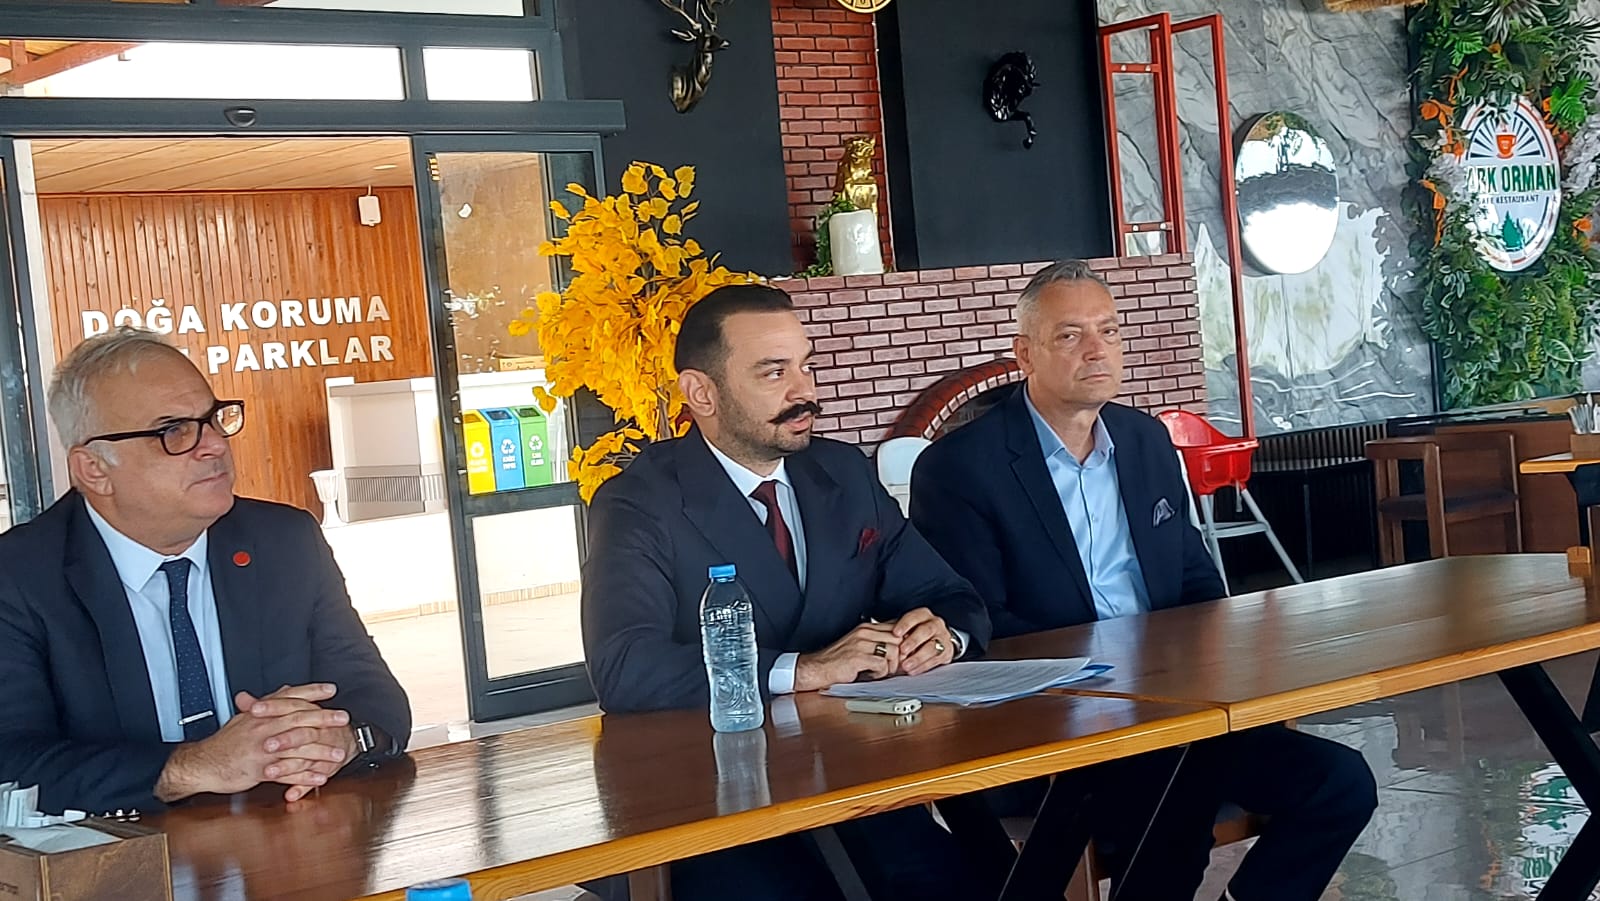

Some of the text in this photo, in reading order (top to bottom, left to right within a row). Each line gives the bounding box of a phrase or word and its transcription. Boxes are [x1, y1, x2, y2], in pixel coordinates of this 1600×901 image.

[1464, 163, 1557, 193] ARK ORMAN
[1496, 194, 1539, 204] RESTAURANT
[82, 295, 390, 339] DOĞA KORUMA
[207, 335, 394, 374] PARKLAR
